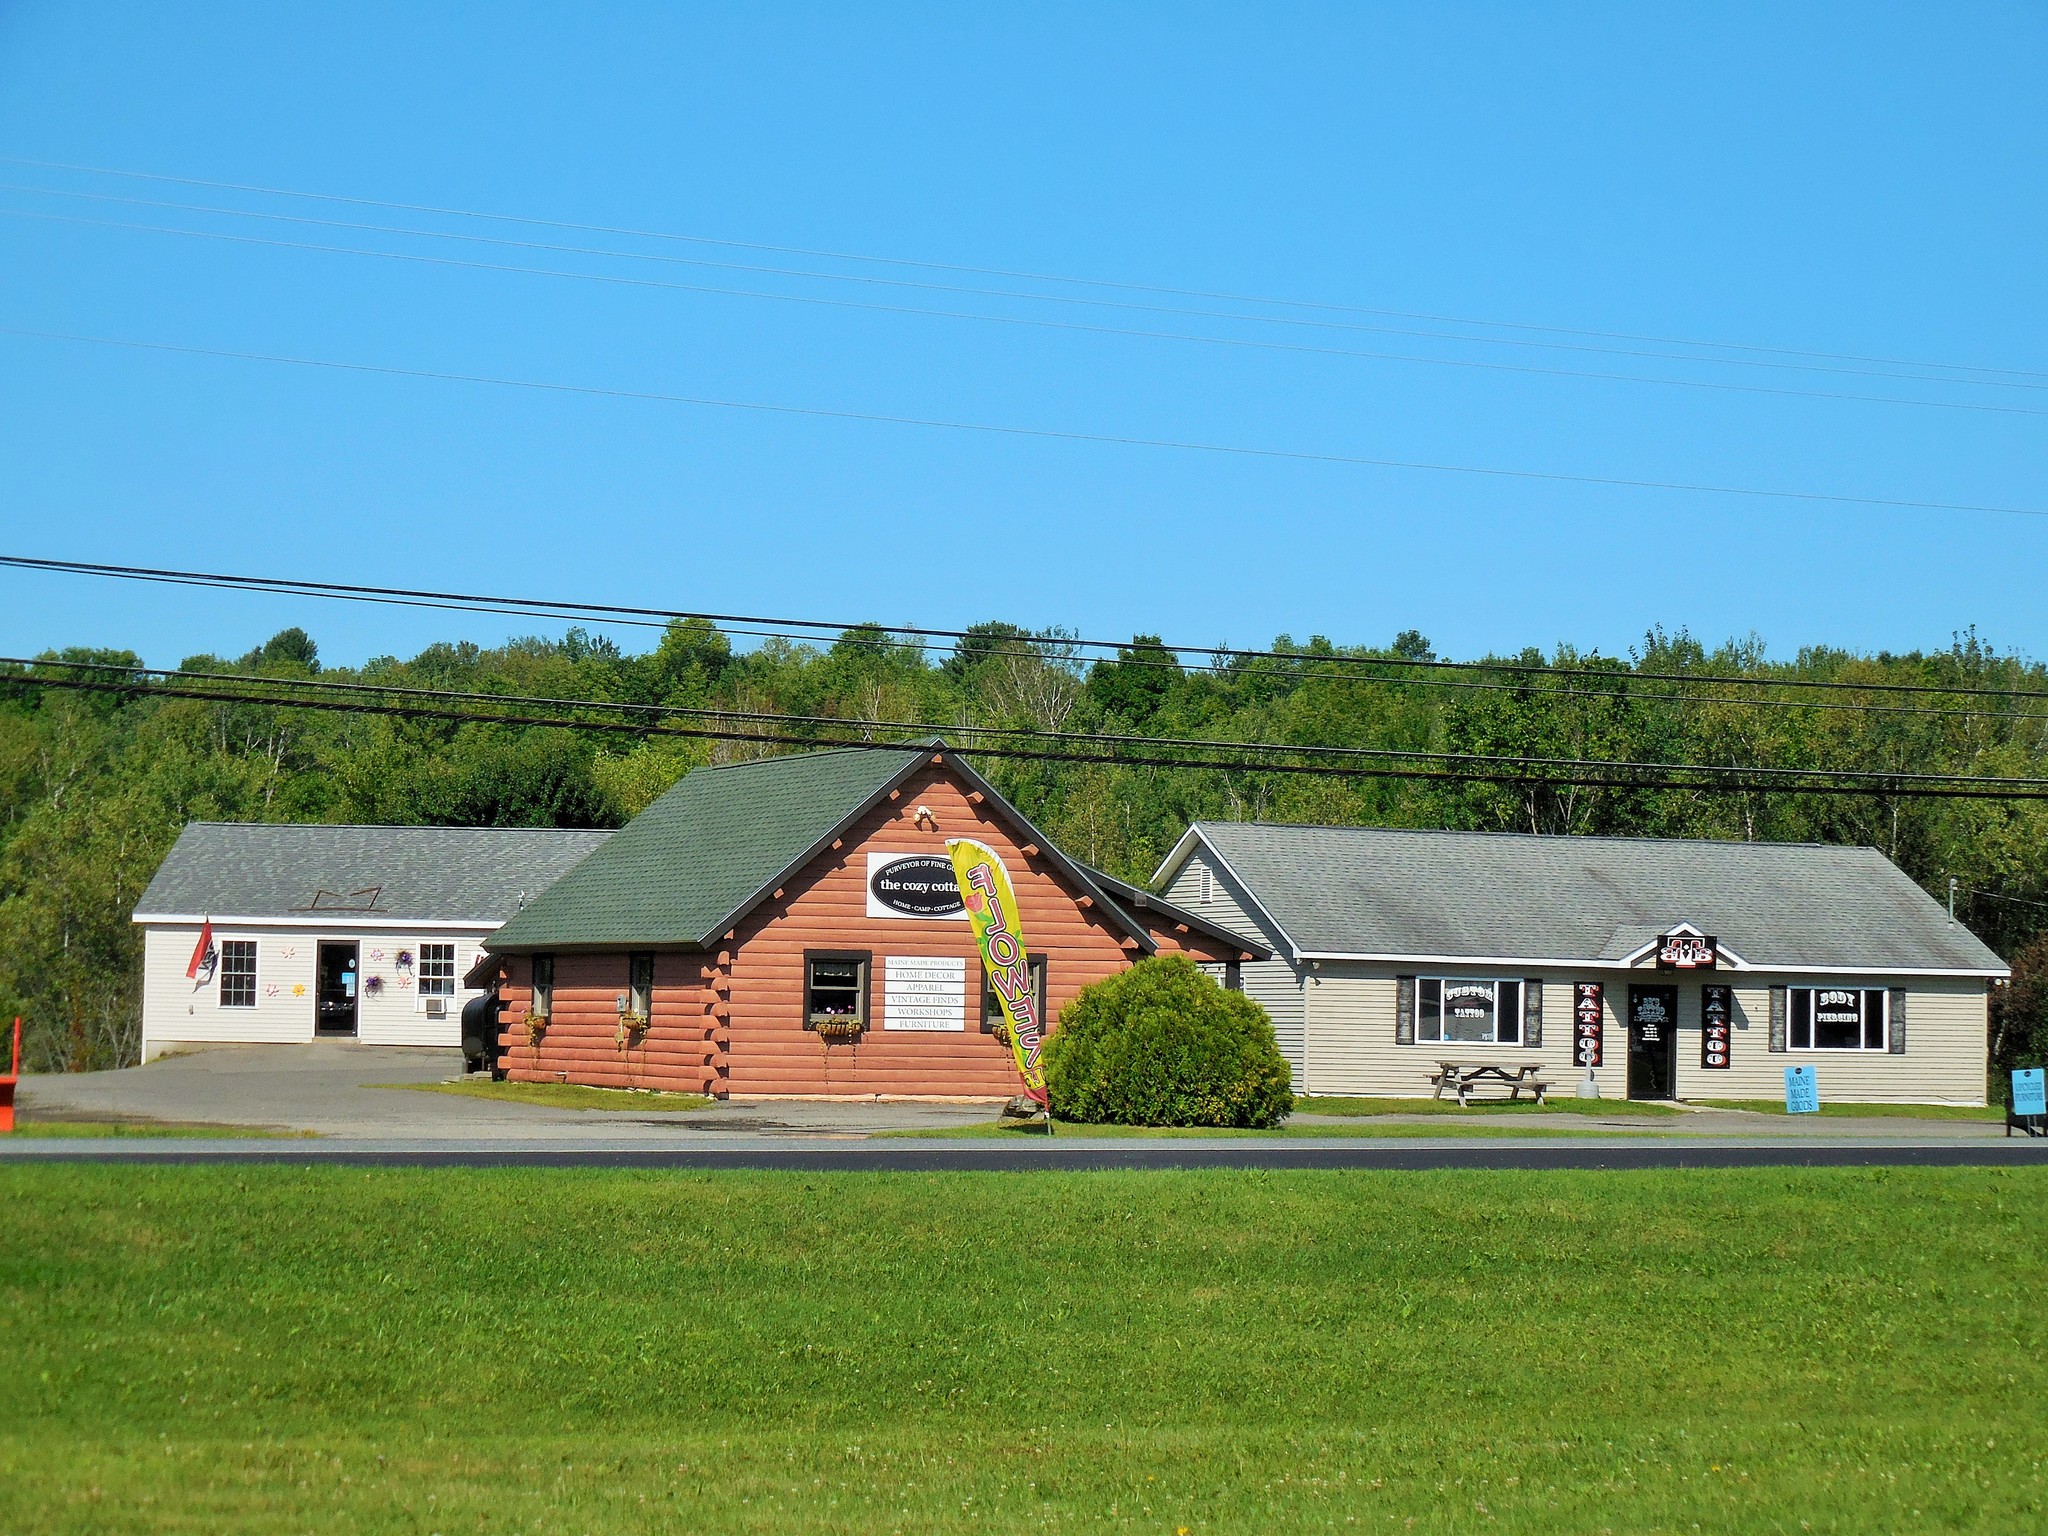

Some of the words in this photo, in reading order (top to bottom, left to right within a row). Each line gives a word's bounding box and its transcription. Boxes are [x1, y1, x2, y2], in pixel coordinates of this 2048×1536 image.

[885, 860, 920, 876] PURVEYOR
[930, 860, 946, 869] FINE
[880, 879, 900, 890] the
[902, 882, 930, 894] cozy
[932, 881, 960, 892] cotta
[892, 899, 911, 910] HOME
[914, 903, 931, 912] CAMP
[934, 901, 961, 911] COTTAGE
[895, 971, 923, 979] HOME
[906, 984, 944, 992] APPAREL
[891, 995, 931, 1003] VINTAGE
[932, 996, 959, 1004] FINDS
[1819, 991, 1855, 1007] BODY
[898, 1008, 953, 1016] WORKSHOPS
[1454, 1008, 1485, 1018] TATTOO
[899, 1020, 950, 1029] FURNITURE
[1577, 984, 1600, 1064] TATTOO
[1705, 987, 1727, 1066] TATTOO
[1788, 1076, 1810, 1087] MAINE
[1790, 1088, 1810, 1099] MADE
[1791, 1100, 1813, 1111] GOODS
